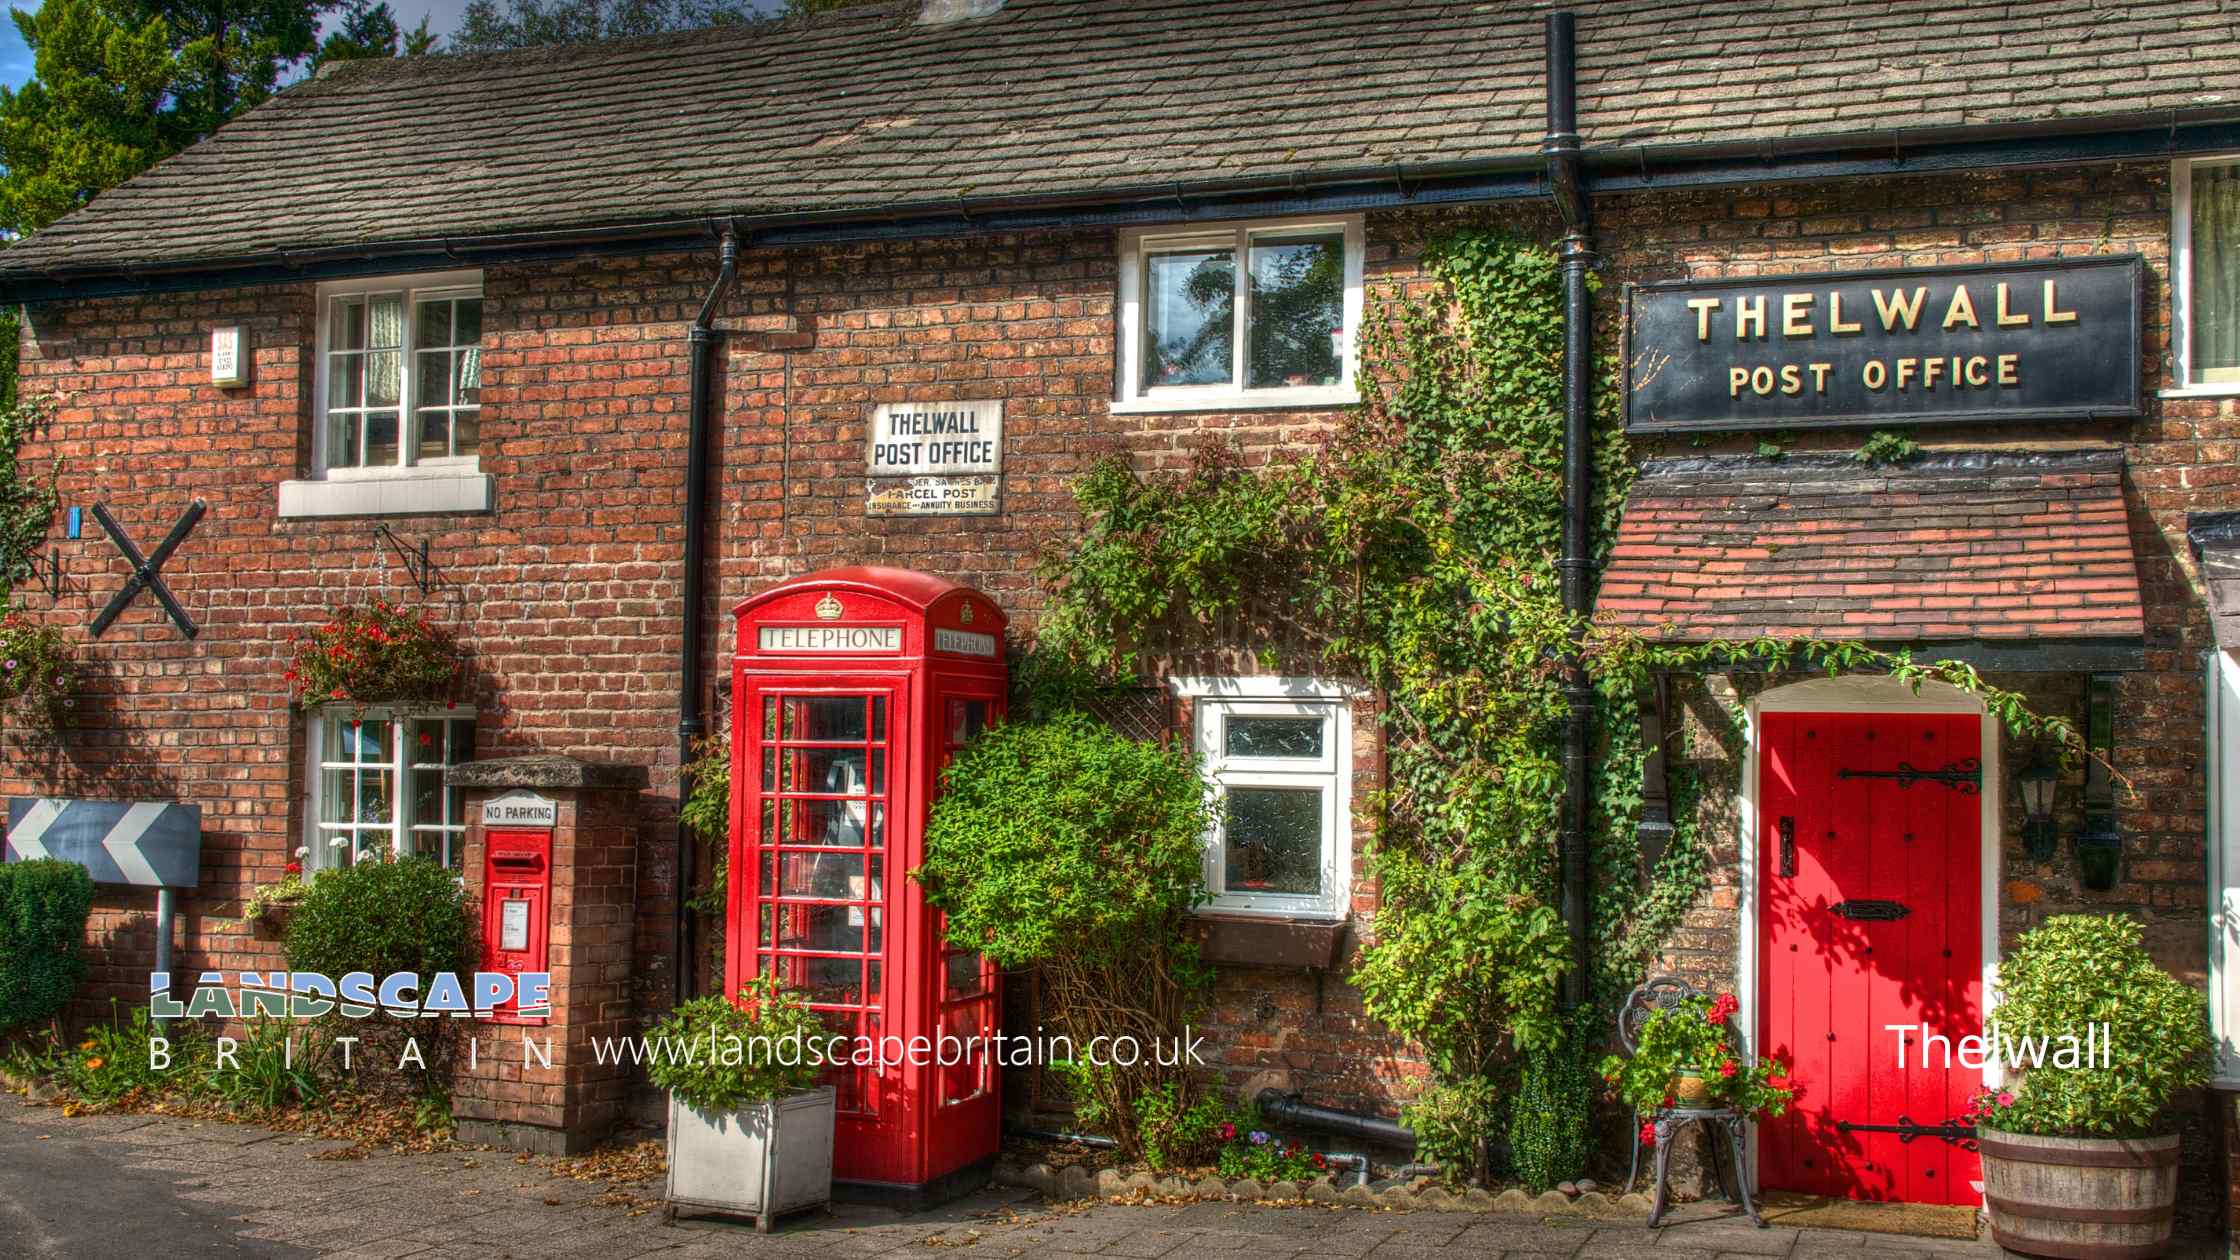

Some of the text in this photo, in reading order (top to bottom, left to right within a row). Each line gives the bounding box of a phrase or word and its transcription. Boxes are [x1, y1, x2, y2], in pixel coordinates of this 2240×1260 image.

[1687, 279, 2078, 341] THELWALL
[1729, 353, 2020, 397] POST OFFICE
[889, 411, 979, 435] THELWALL
[874, 441, 993, 466] POST OFFICE
[943, 488, 977, 499] POST
[920, 501, 952, 510] ANNUITY
[955, 500, 994, 509] BUSINESS
[766, 629, 896, 649] TELEPHONE
[486, 806, 552, 820] NO PARKING
